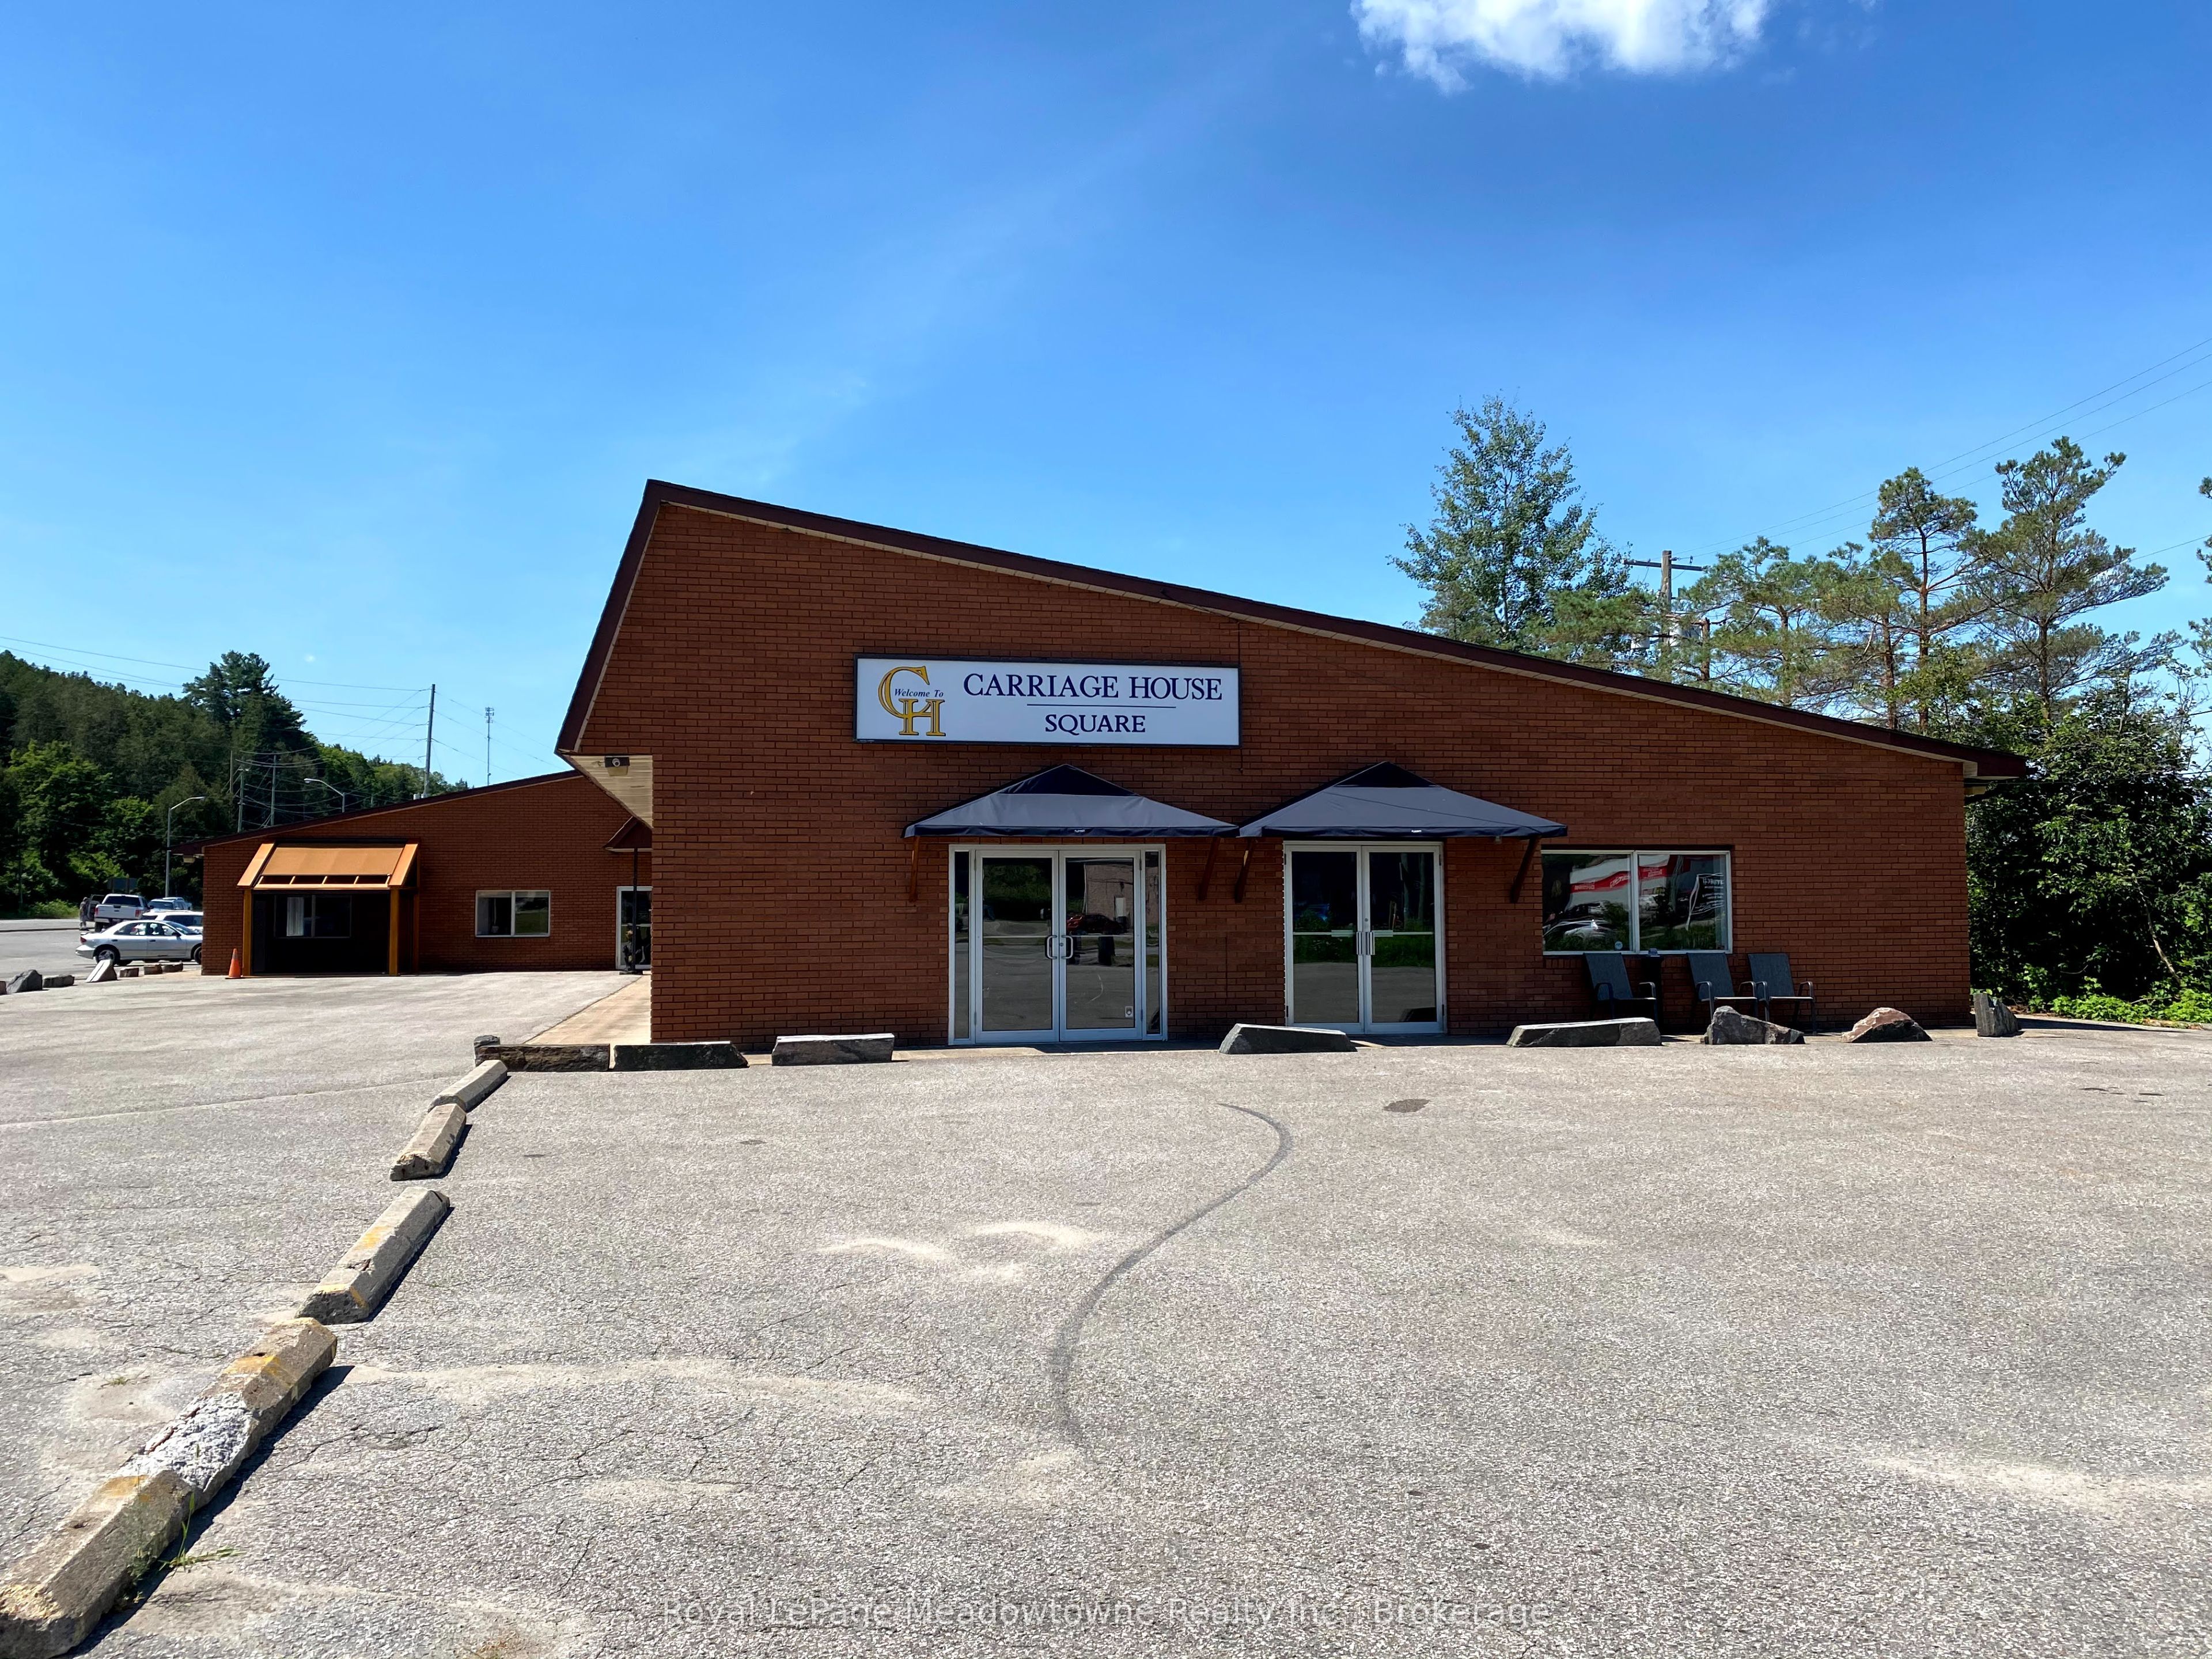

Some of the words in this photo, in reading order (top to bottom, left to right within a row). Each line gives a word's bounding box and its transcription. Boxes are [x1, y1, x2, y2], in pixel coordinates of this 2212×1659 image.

[895, 688, 930, 697] Welcome
[934, 690, 944, 698] To
[964, 673, 1119, 698] CARRIAGE
[1128, 677, 1222, 700] HOUSE
[1045, 714, 1146, 736] SQUARE
